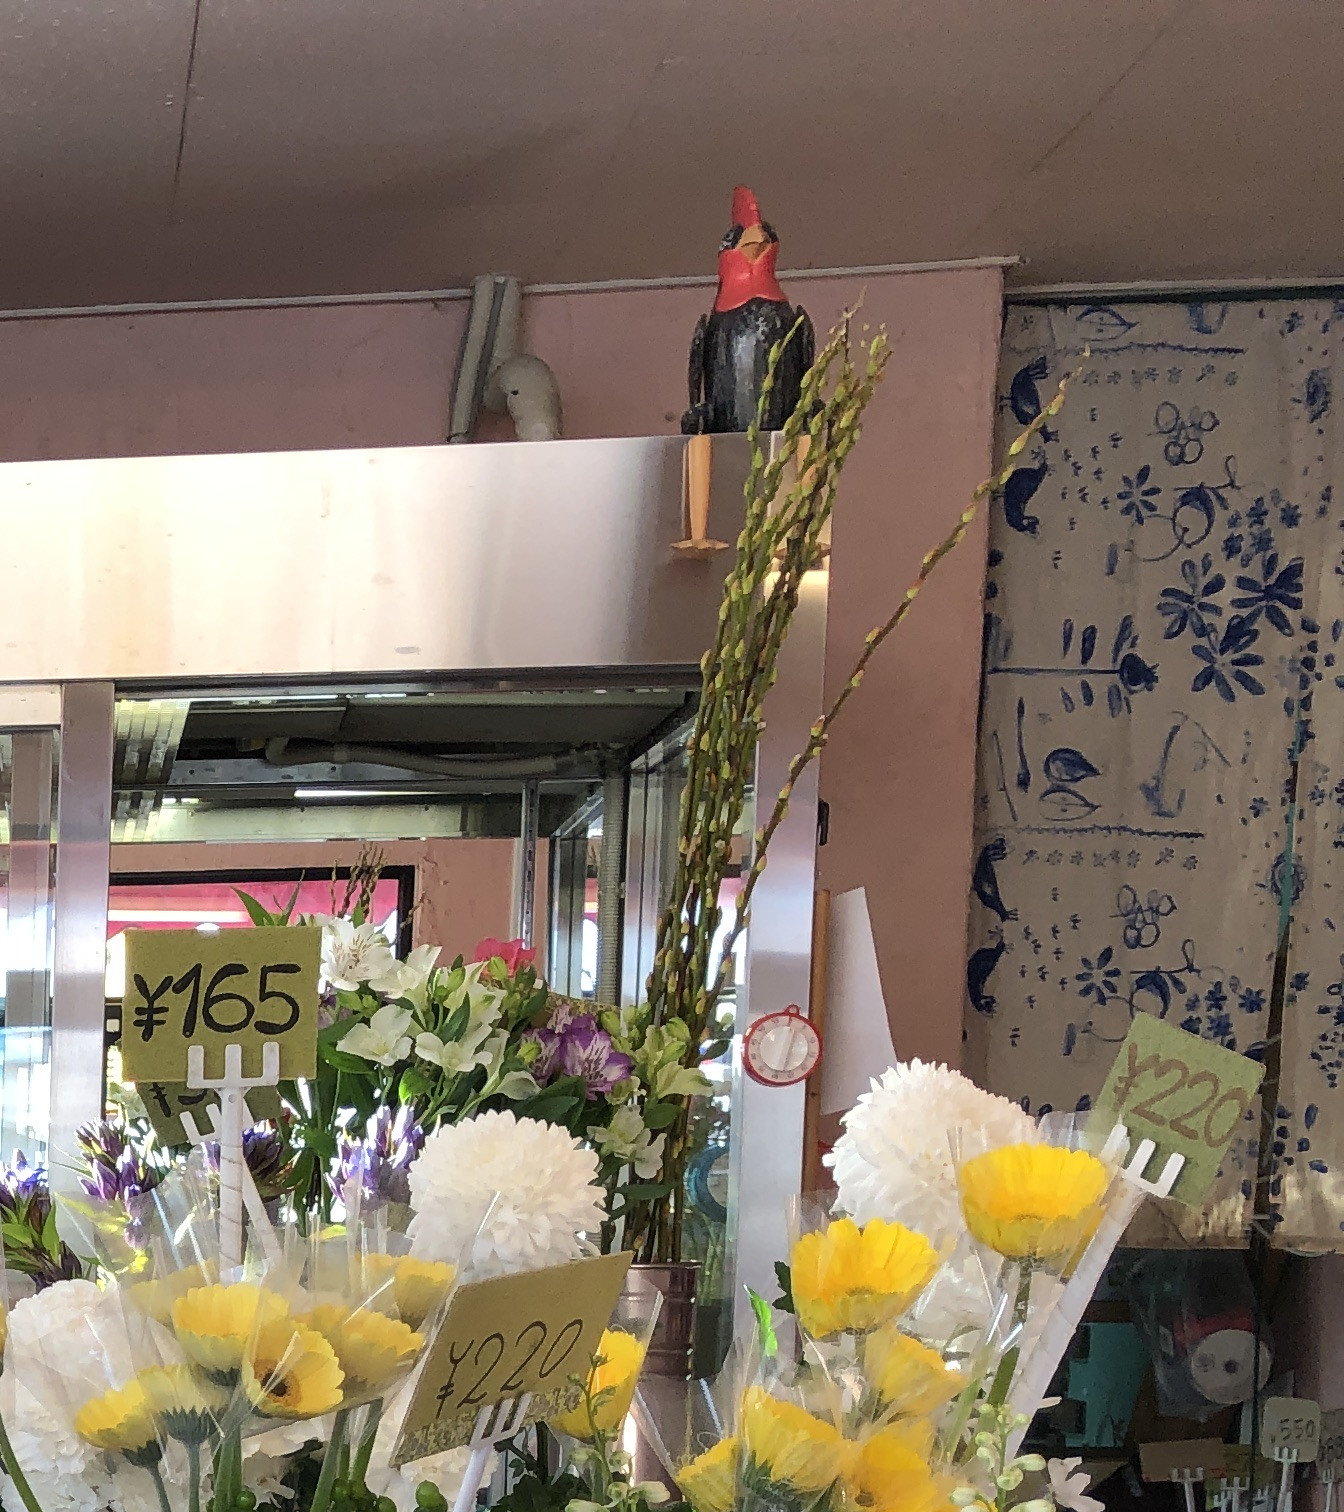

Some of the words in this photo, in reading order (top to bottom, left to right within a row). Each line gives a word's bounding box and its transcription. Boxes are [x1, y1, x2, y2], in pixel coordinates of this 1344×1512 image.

[133, 963, 302, 1043] ¥165
[1113, 1042, 1249, 1149] ¥220
[436, 1318, 584, 1420] ¥220
